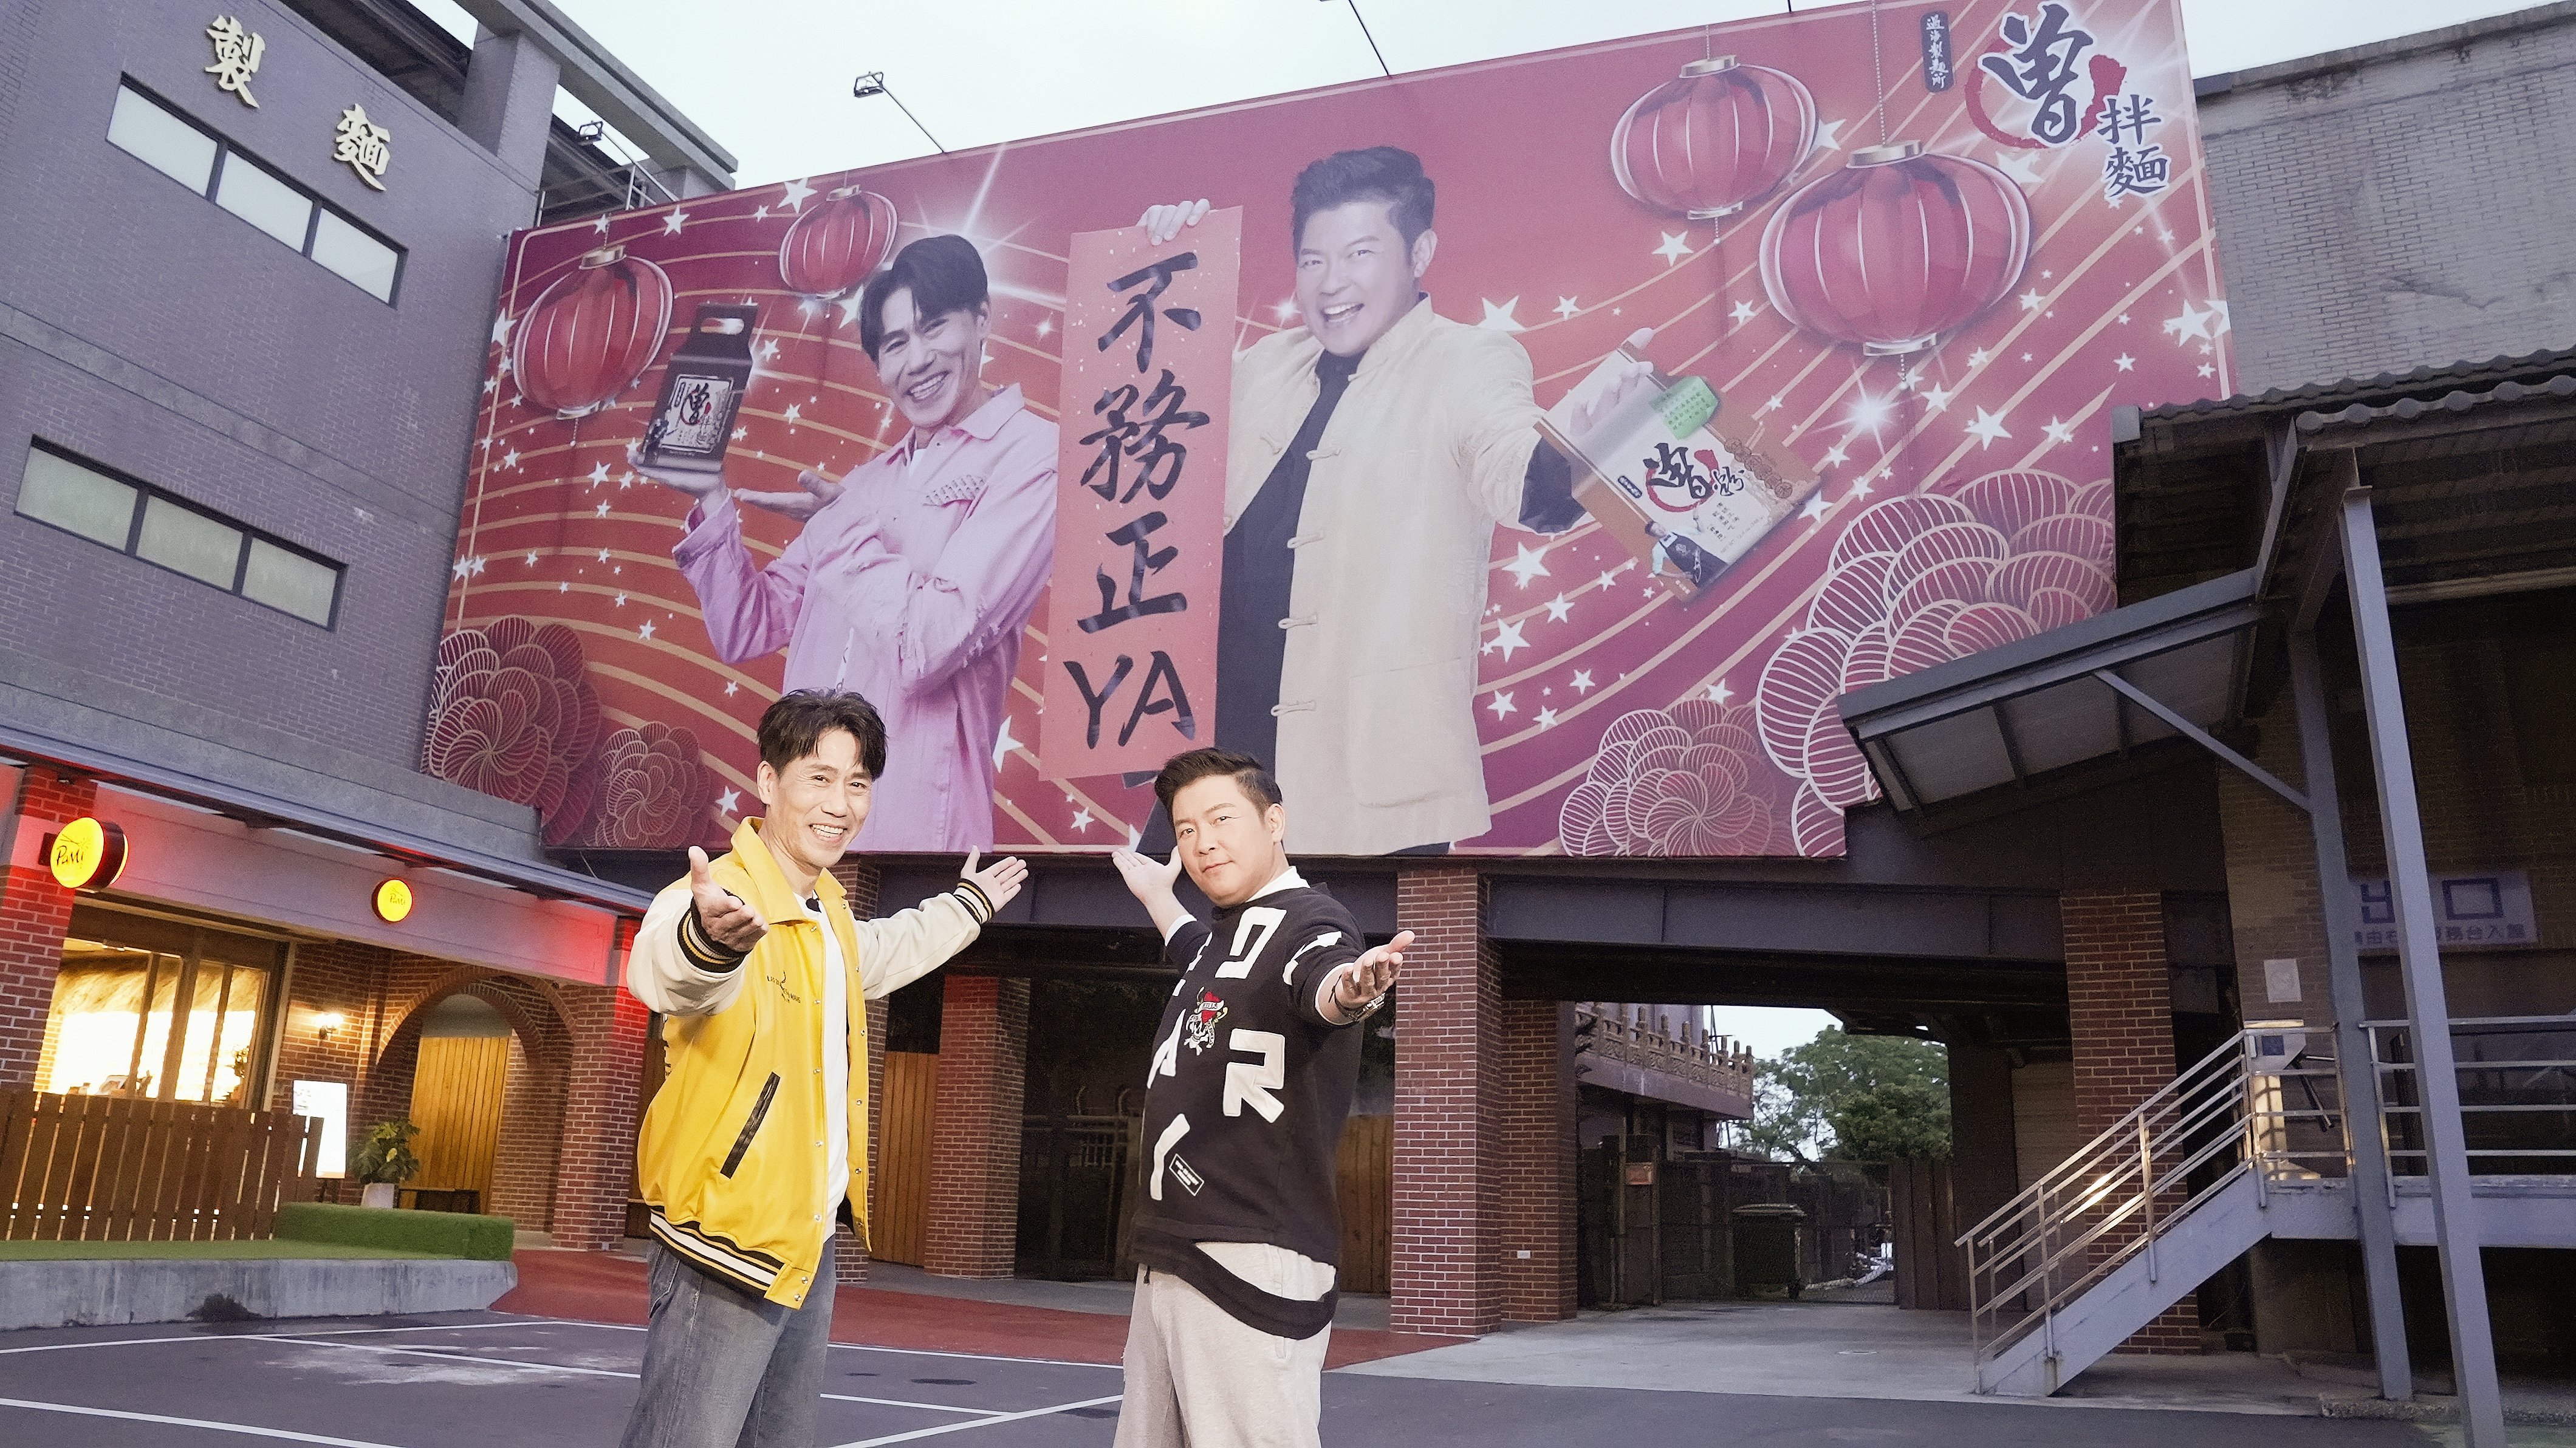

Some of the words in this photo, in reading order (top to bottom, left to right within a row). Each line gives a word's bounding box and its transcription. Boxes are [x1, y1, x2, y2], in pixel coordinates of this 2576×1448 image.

[205, 15, 391, 191] 製麵
[1982, 3, 2094, 145] 曾
[2098, 94, 2170, 197] 拌麵
